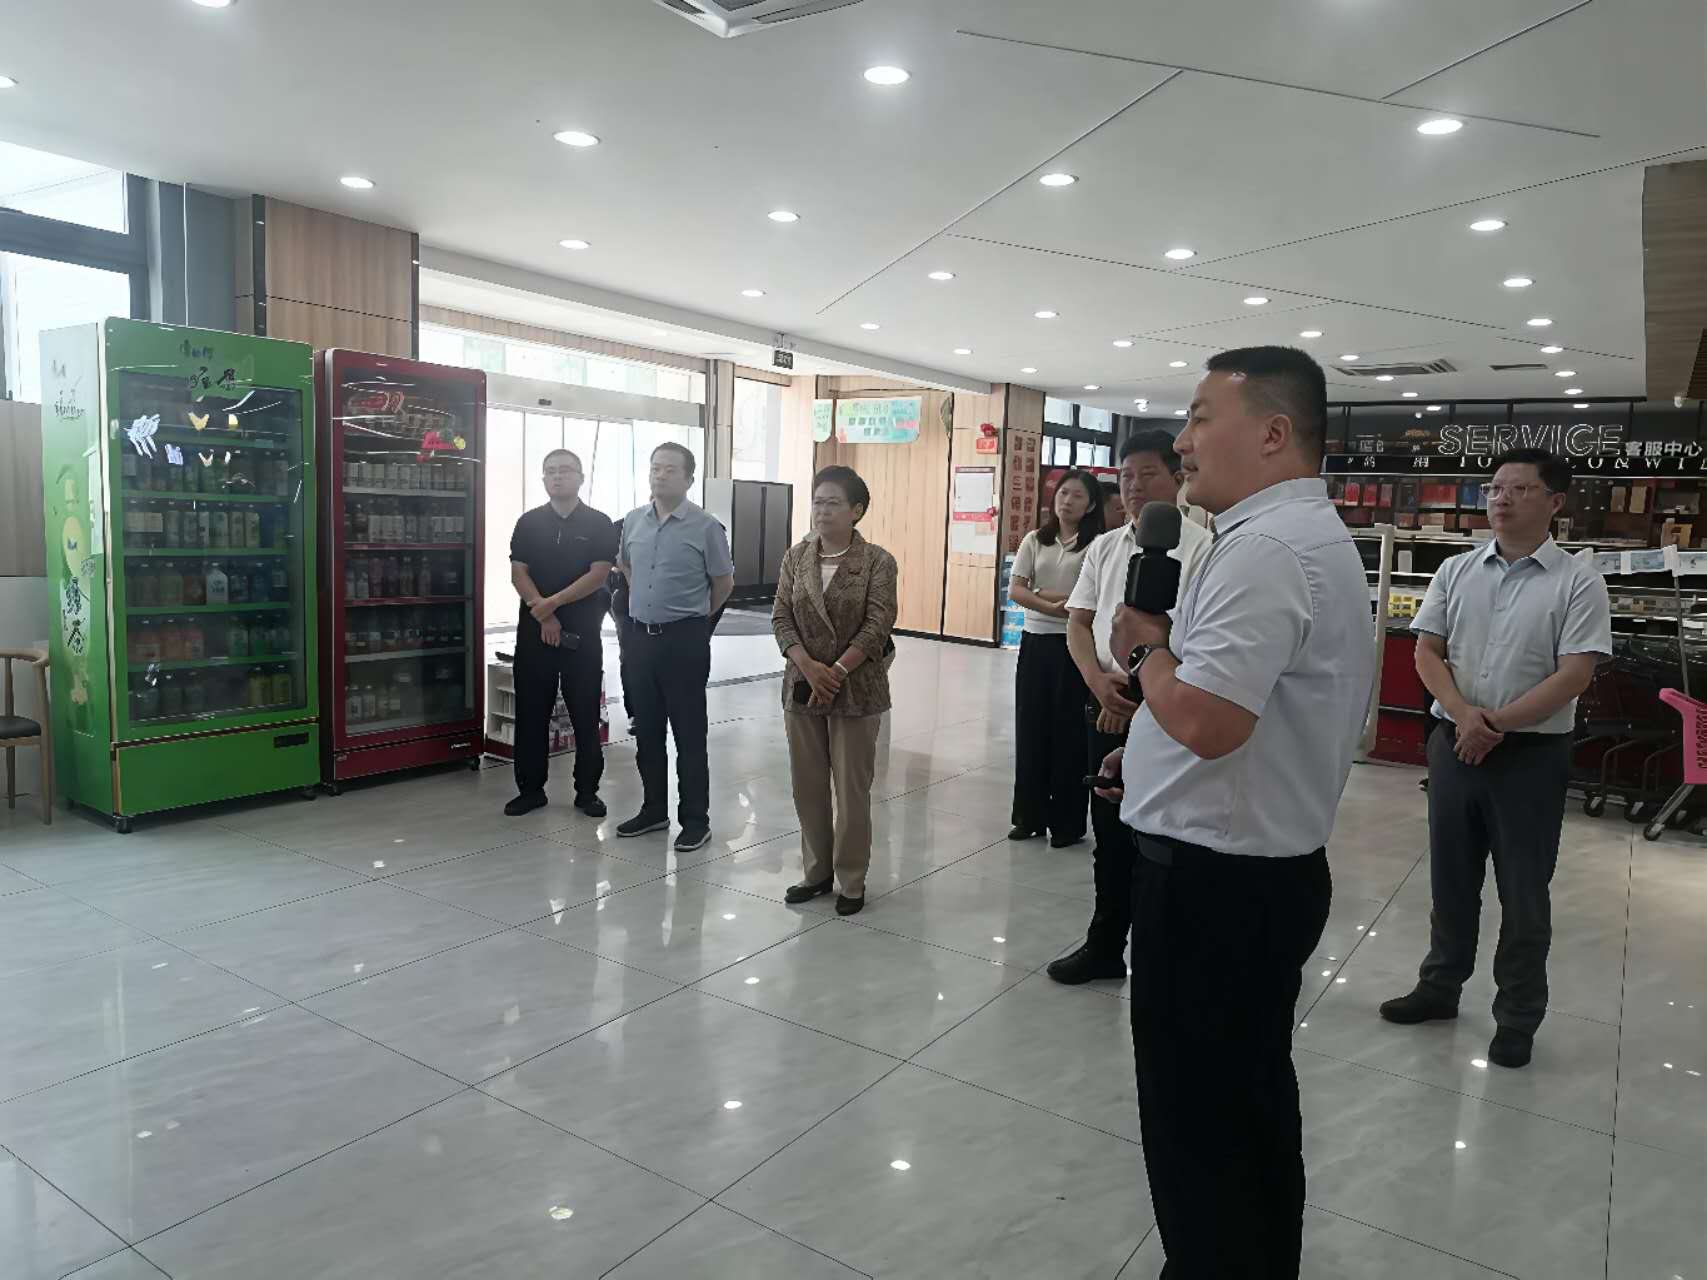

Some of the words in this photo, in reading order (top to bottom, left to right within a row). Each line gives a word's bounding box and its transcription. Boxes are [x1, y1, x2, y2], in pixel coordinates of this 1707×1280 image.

[1438, 424, 1623, 456] SERVICE
[1625, 440, 1702, 457] 客服中心
